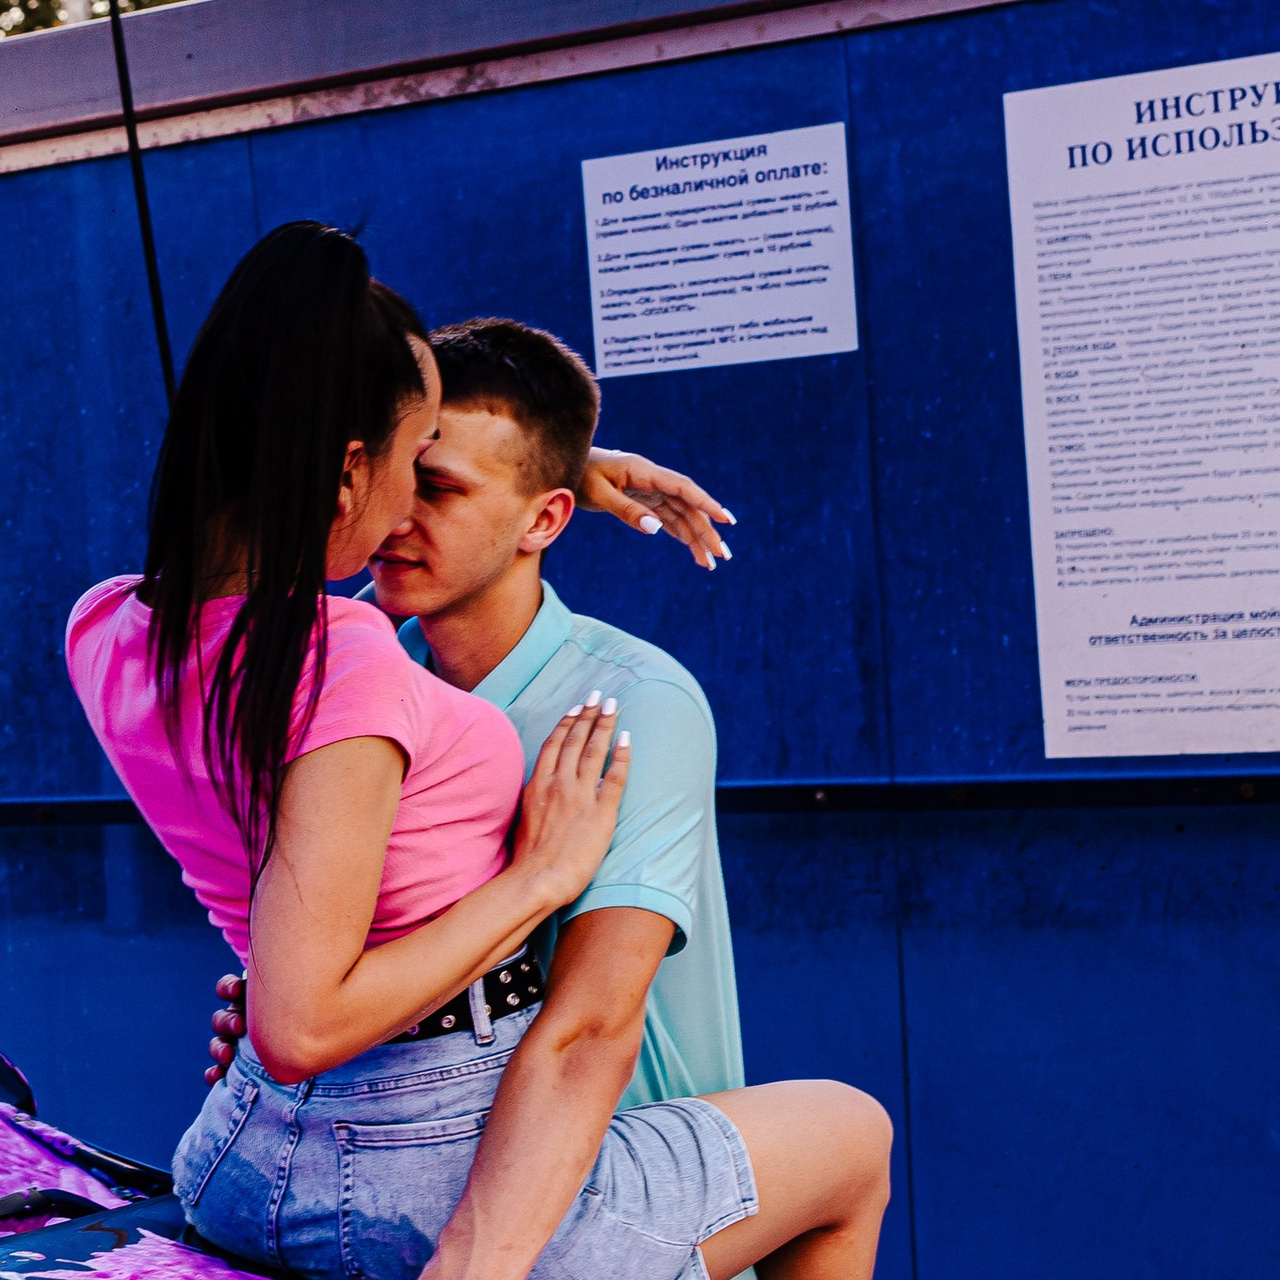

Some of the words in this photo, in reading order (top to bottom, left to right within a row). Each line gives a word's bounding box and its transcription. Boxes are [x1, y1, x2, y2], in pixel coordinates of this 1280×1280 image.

[655, 144, 768, 171] Инструкция
[1067, 141, 1113, 169] ПО
[602, 191, 624, 204] по
[629, 170, 749, 201] безналичной
[755, 161, 828, 183] оплате:
